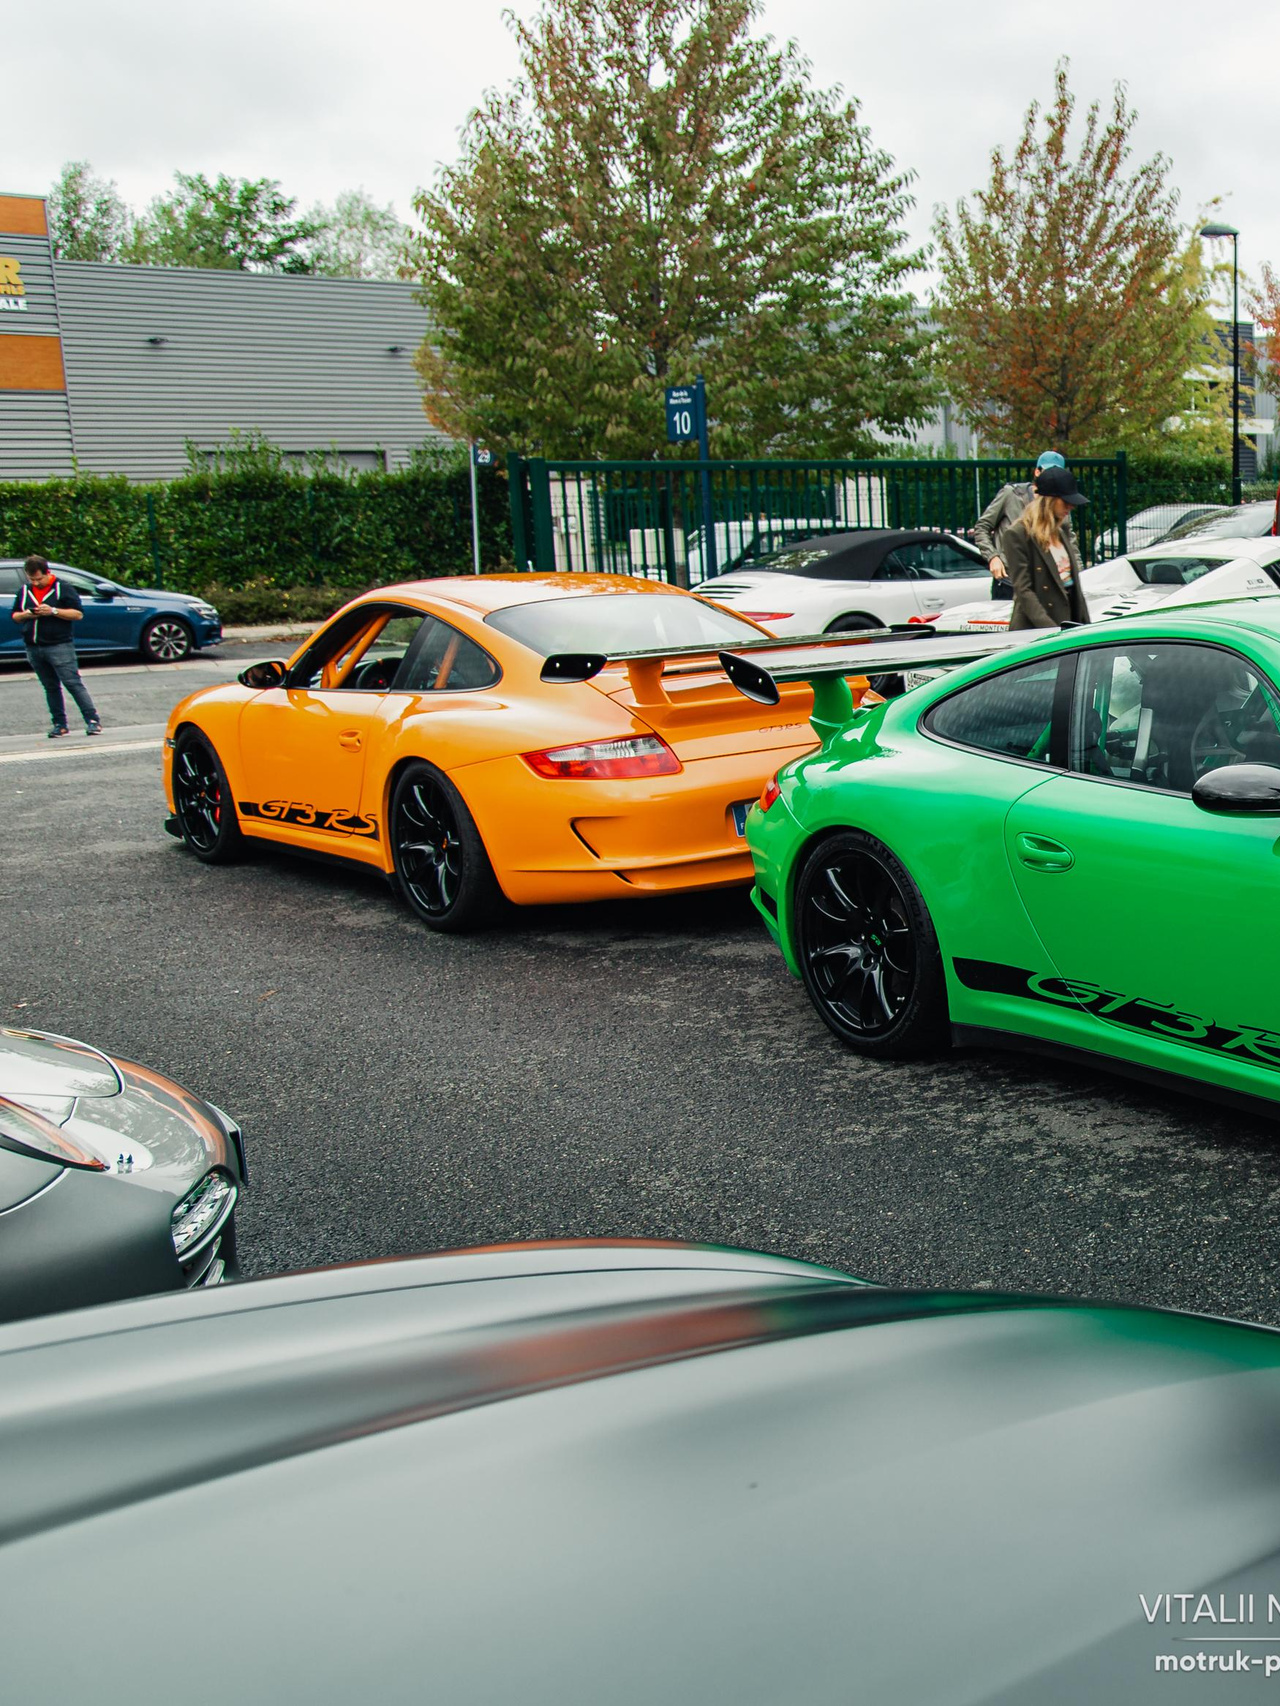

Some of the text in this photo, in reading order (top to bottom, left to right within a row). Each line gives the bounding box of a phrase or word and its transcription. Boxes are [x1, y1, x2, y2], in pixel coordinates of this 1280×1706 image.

[0, 257, 24, 284] R
[0, 298, 28, 310] ALE
[673, 411, 691, 435] 10
[1027, 976, 1217, 1039] GT3
